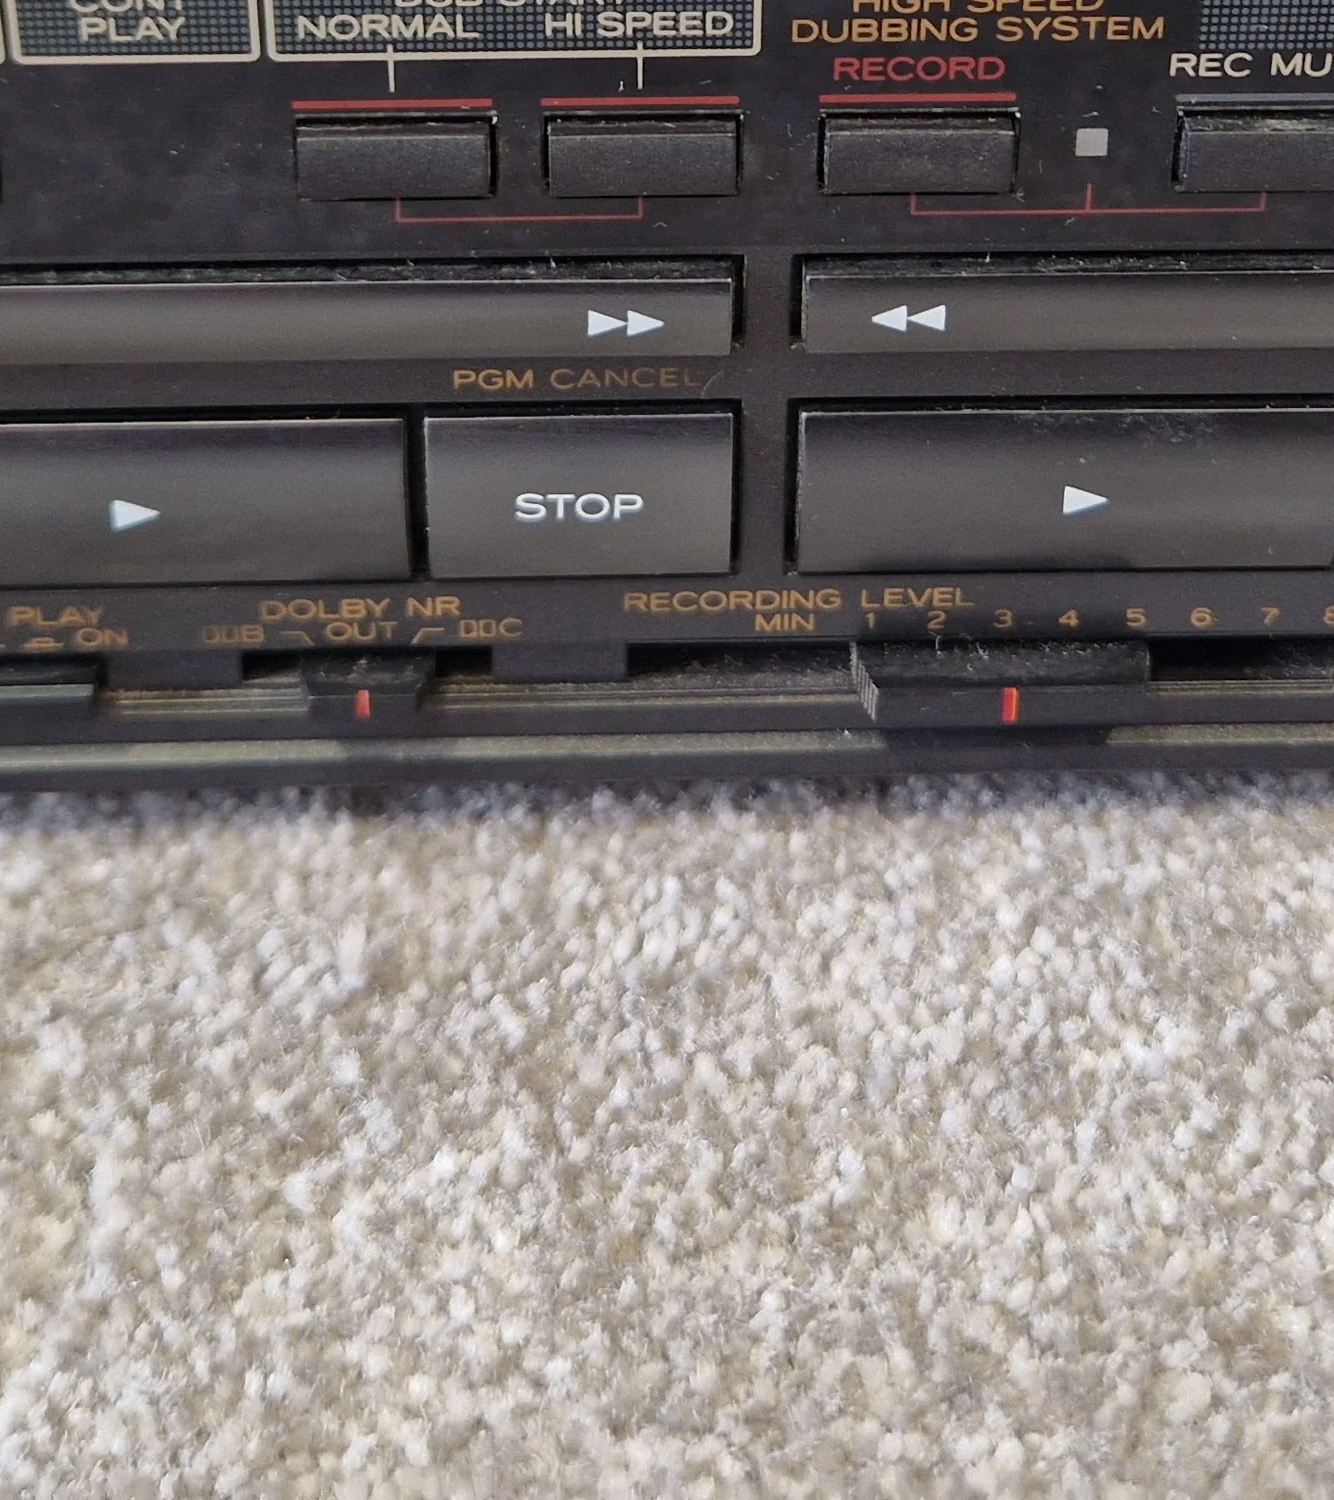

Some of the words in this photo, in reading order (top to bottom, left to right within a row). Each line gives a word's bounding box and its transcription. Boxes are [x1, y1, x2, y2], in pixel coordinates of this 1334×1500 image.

[79, 16, 186, 43] PLAY
[296, 13, 481, 40] NORMAL
[544, 11, 583, 37] HI
[596, 10, 735, 37] SPEED
[790, 18, 979, 44] DUBBING
[994, 17, 1165, 42] SYSTEM
[833, 56, 1006, 82] RECORD
[1169, 51, 1254, 78] REC
[453, 369, 535, 391] PGM
[550, 367, 701, 390] CANCEL
[514, 492, 645, 522] STOP
[259, 599, 391, 622] DOLBY
[407, 596, 462, 618] NR
[623, 589, 842, 615] RECORDING
[861, 587, 973, 610] LEVEL
[7, 604, 104, 628] PLAY
[755, 613, 815, 632] MIN
[864, 611, 876, 630] 1
[927, 610, 948, 630] 2
[992, 609, 1015, 629] 3
[1058, 609, 1080, 628] 4
[1125, 607, 1148, 629] 5
[1190, 606, 1215, 628] 6
[1260, 607, 1280, 627] 7
[74, 627, 128, 650] ON
[322, 621, 398, 641] OUT
